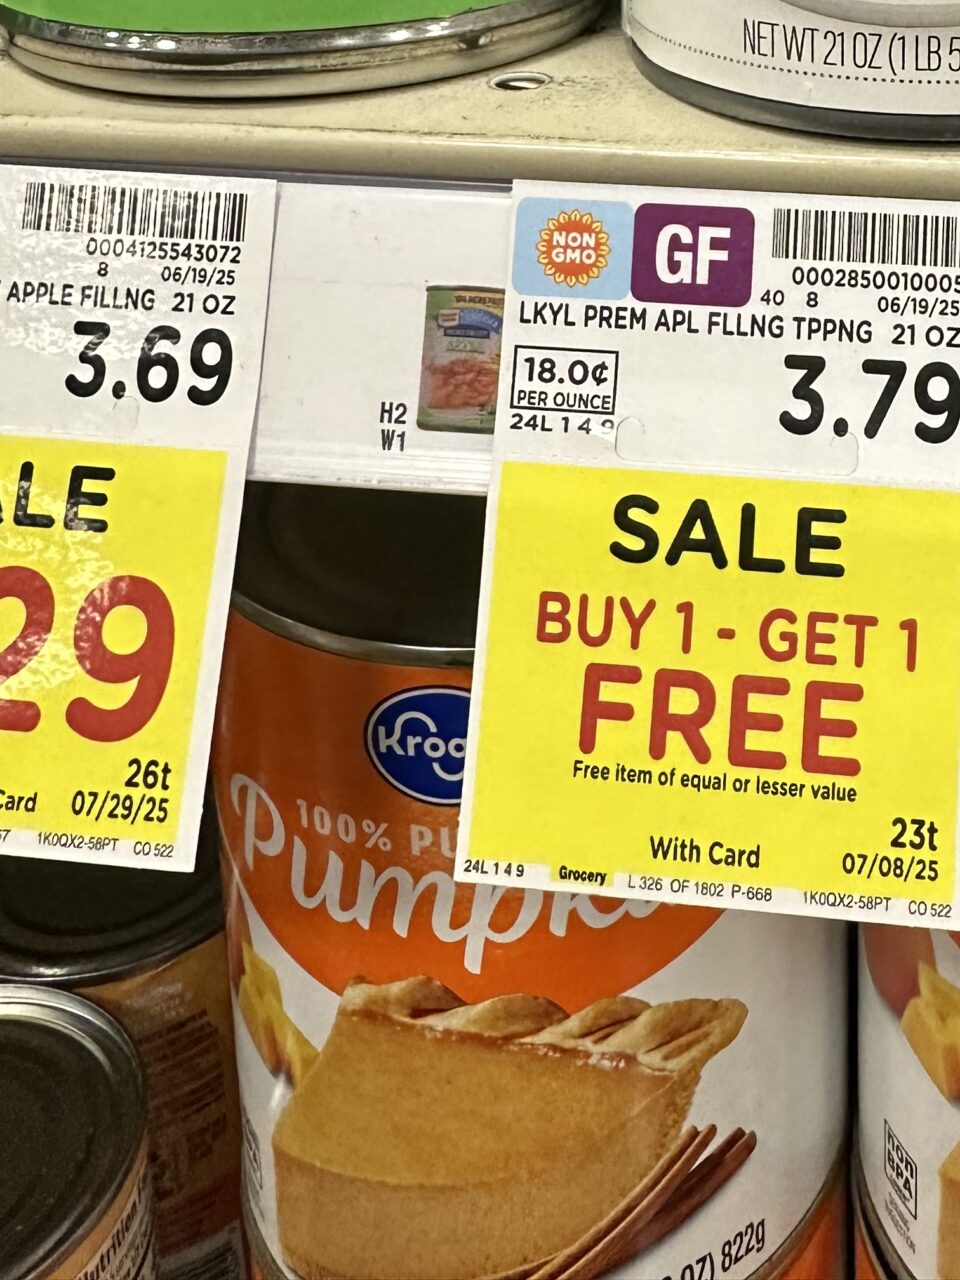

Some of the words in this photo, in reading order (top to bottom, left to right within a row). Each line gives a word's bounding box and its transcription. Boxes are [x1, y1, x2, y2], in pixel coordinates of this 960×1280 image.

[742, 18, 779, 55] NET
[783, 26, 819, 64] WT
[853, 32, 883, 69] OZ
[914, 36, 942, 71] LB
[86, 237, 242, 264] 0004125543072
[551, 230, 596, 248] NON
[551, 246, 596, 266] GMO
[655, 223, 731, 285] GF
[160, 266, 236, 287] 06/19/25
[6, 281, 74, 306] APPLE
[80, 285, 155, 311] FILLNG
[202, 294, 237, 315] OZ
[760, 289, 785, 307] 40
[806, 292, 819, 308] 8
[877, 297, 960, 318] 06/19/25
[518, 300, 576, 328] LKYL
[584, 304, 648, 332] PREM
[654, 308, 700, 335] APL
[707, 310, 784, 339] FLLNG
[793, 315, 873, 344] TPPNG
[65, 320, 233, 407] 3.69
[380, 401, 407, 424] H2
[516, 390, 548, 408] PER
[552, 392, 613, 412] OUNCE
[510, 413, 552, 432] 24L
[381, 429, 406, 452] W1
[610, 494, 847, 578] SALE
[536, 591, 657, 651] BUY
[759, 608, 878, 668] GET
[579, 662, 865, 777] FREE
[125, 757, 172, 791] 26t
[573, 759, 609, 781] Free
[615, 763, 652, 785] item
[658, 767, 676, 787] of
[680, 772, 727, 796] equal
[732, 777, 751, 794] or
[756, 775, 806, 799] lesser
[810, 780, 857, 803] value
[71, 790, 169, 825] 07/29/25
[296, 799, 391, 852] 100%
[890, 817, 940, 850] 23t
[153, 843, 174, 858] 522
[650, 835, 700, 864] With
[708, 840, 760, 868] Card
[842, 852, 940, 883] 07/08/25
[463, 859, 489, 876] 24L
[558, 866, 607, 886] Grocery
[670, 879, 690, 895] OF
[694, 881, 725, 898] 1802
[731, 885, 773, 902] P-668
[908, 900, 928, 916] CO
[929, 903, 953, 919] 522
[887, 1129, 915, 1179] non
[887, 1149, 913, 1200] BPA
[720, 1218, 766, 1273] 822g
